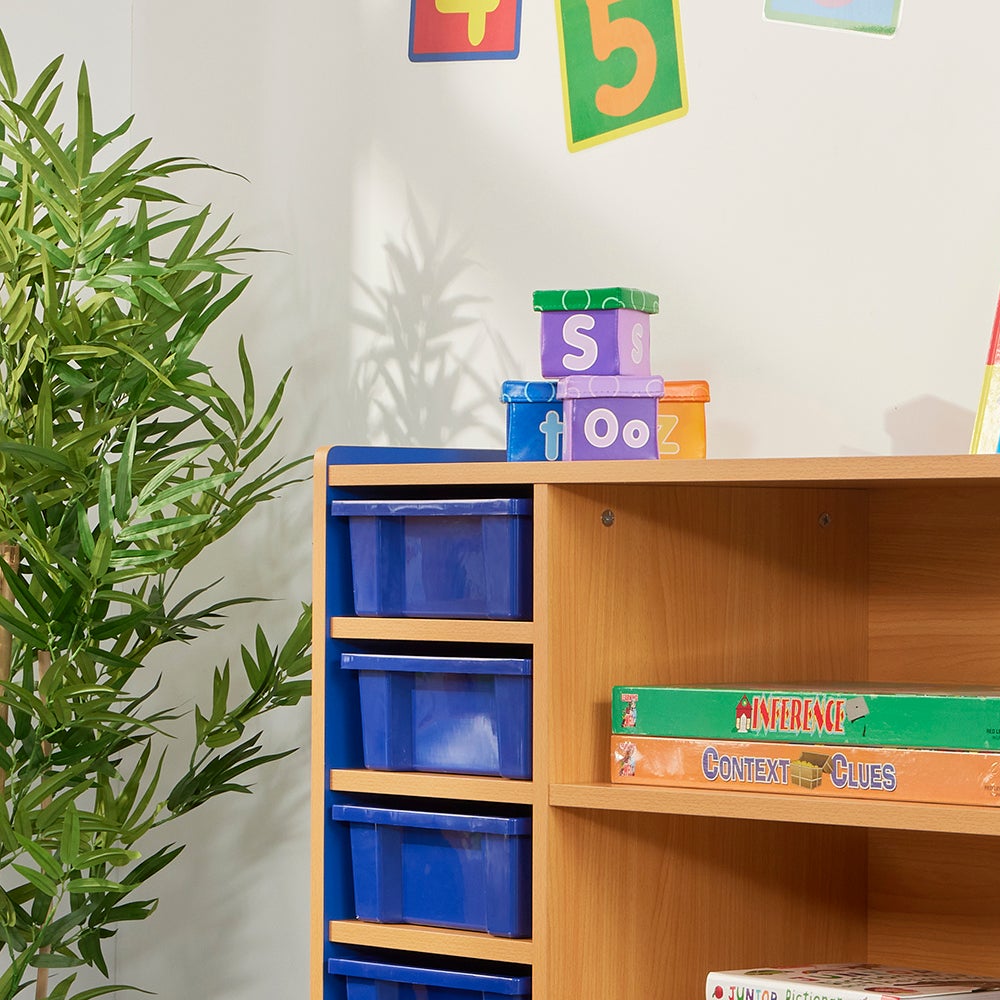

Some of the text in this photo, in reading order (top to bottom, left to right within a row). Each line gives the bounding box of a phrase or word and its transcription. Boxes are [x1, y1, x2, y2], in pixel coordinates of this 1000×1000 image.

[588, 0, 658, 117] 5
[562, 313, 598, 371] S
[539, 410, 564, 461] t
[752, 696, 845, 733] INFERENCE
